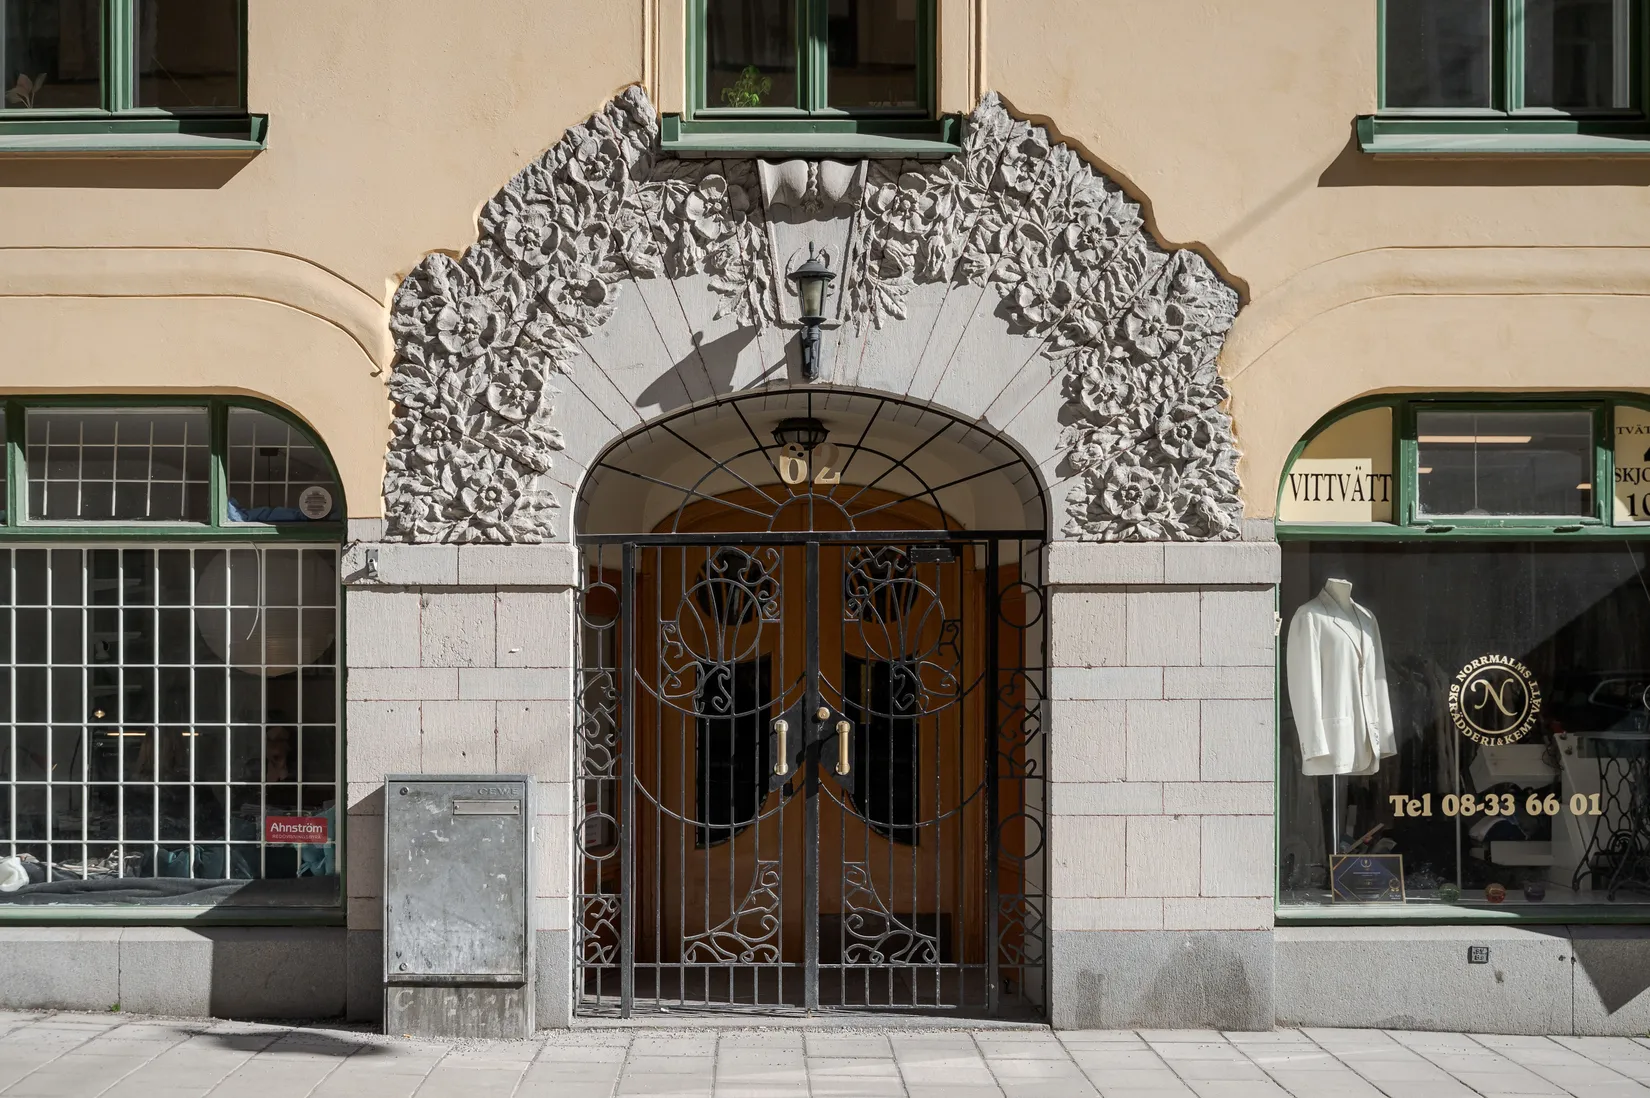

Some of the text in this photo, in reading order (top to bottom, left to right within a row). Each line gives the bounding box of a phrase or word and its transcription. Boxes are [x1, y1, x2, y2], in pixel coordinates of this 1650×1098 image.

[779, 442, 841, 485] 62
[1288, 465, 1392, 502] VITTVÄTT
[1456, 654, 1532, 682] NORRMALMS
[1470, 678, 1518, 717] N
[477, 787, 519, 796] CEWE
[1389, 793, 1603, 817] Tel 08-33 66 01
[270, 822, 323, 833] Ahnström
